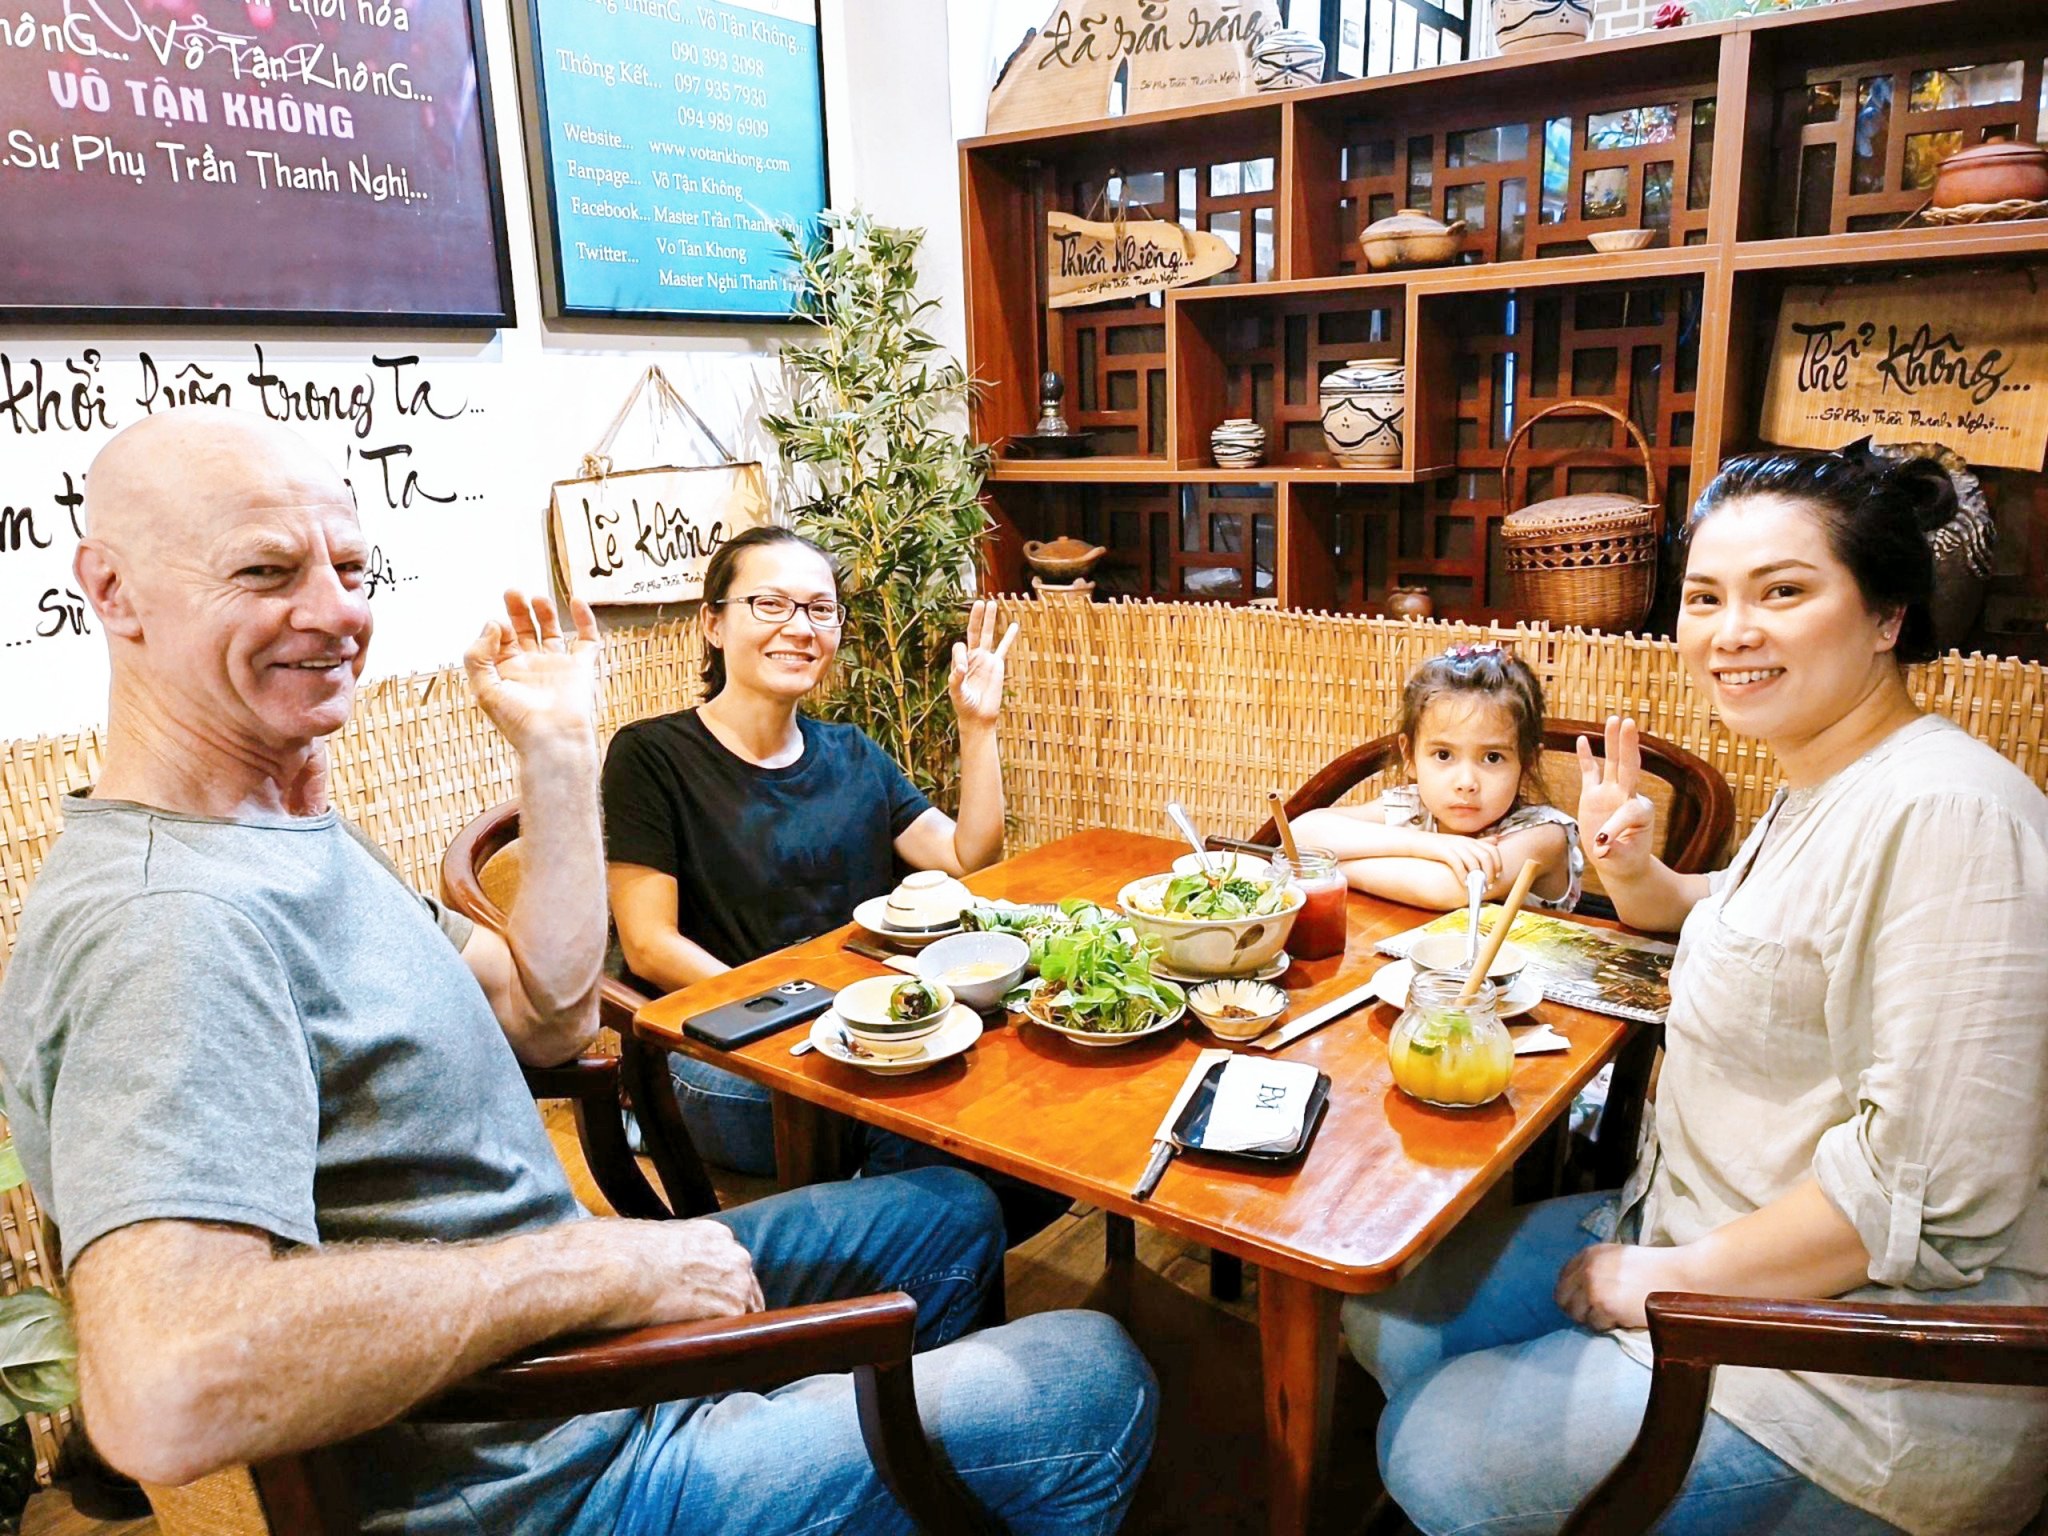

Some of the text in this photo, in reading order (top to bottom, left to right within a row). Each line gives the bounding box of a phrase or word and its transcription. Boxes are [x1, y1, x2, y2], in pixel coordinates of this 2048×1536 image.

[697, 6, 717, 31] Vô
[720, 12, 748, 39] Tận
[141, 20, 205, 70] Vô
[217, 36, 288, 88] Tận
[556, 48, 615, 87] Thông
[672, 40, 764, 78] 090 393 3098
[48, 68, 354, 139] VÔ TẬN KHÔNG
[675, 73, 701, 96] 097
[705, 79, 731, 101] 935
[678, 106, 769, 138] 094 989 6909
[72, 134, 146, 185] Phụ
[156, 141, 237, 184] Trần
[246, 150, 339, 192] Thanh
[649, 140, 791, 173] www.votankhong.com
[652, 171, 670, 190] Vô
[672, 173, 698, 194] Tận
[701, 176, 743, 202] Không
[653, 206, 699, 226] Master
[702, 209, 732, 229] Trần
[734, 213, 773, 233] Thanh
[656, 237, 676, 255] Vo
[678, 239, 702, 257] Tan
[705, 241, 747, 265] Khong
[659, 269, 703, 288] Master
[707, 272, 737, 293] Nghi
[740, 274, 778, 292] Thanh
[1792, 321, 1875, 392] Thể
[247, 343, 375, 439] trong
